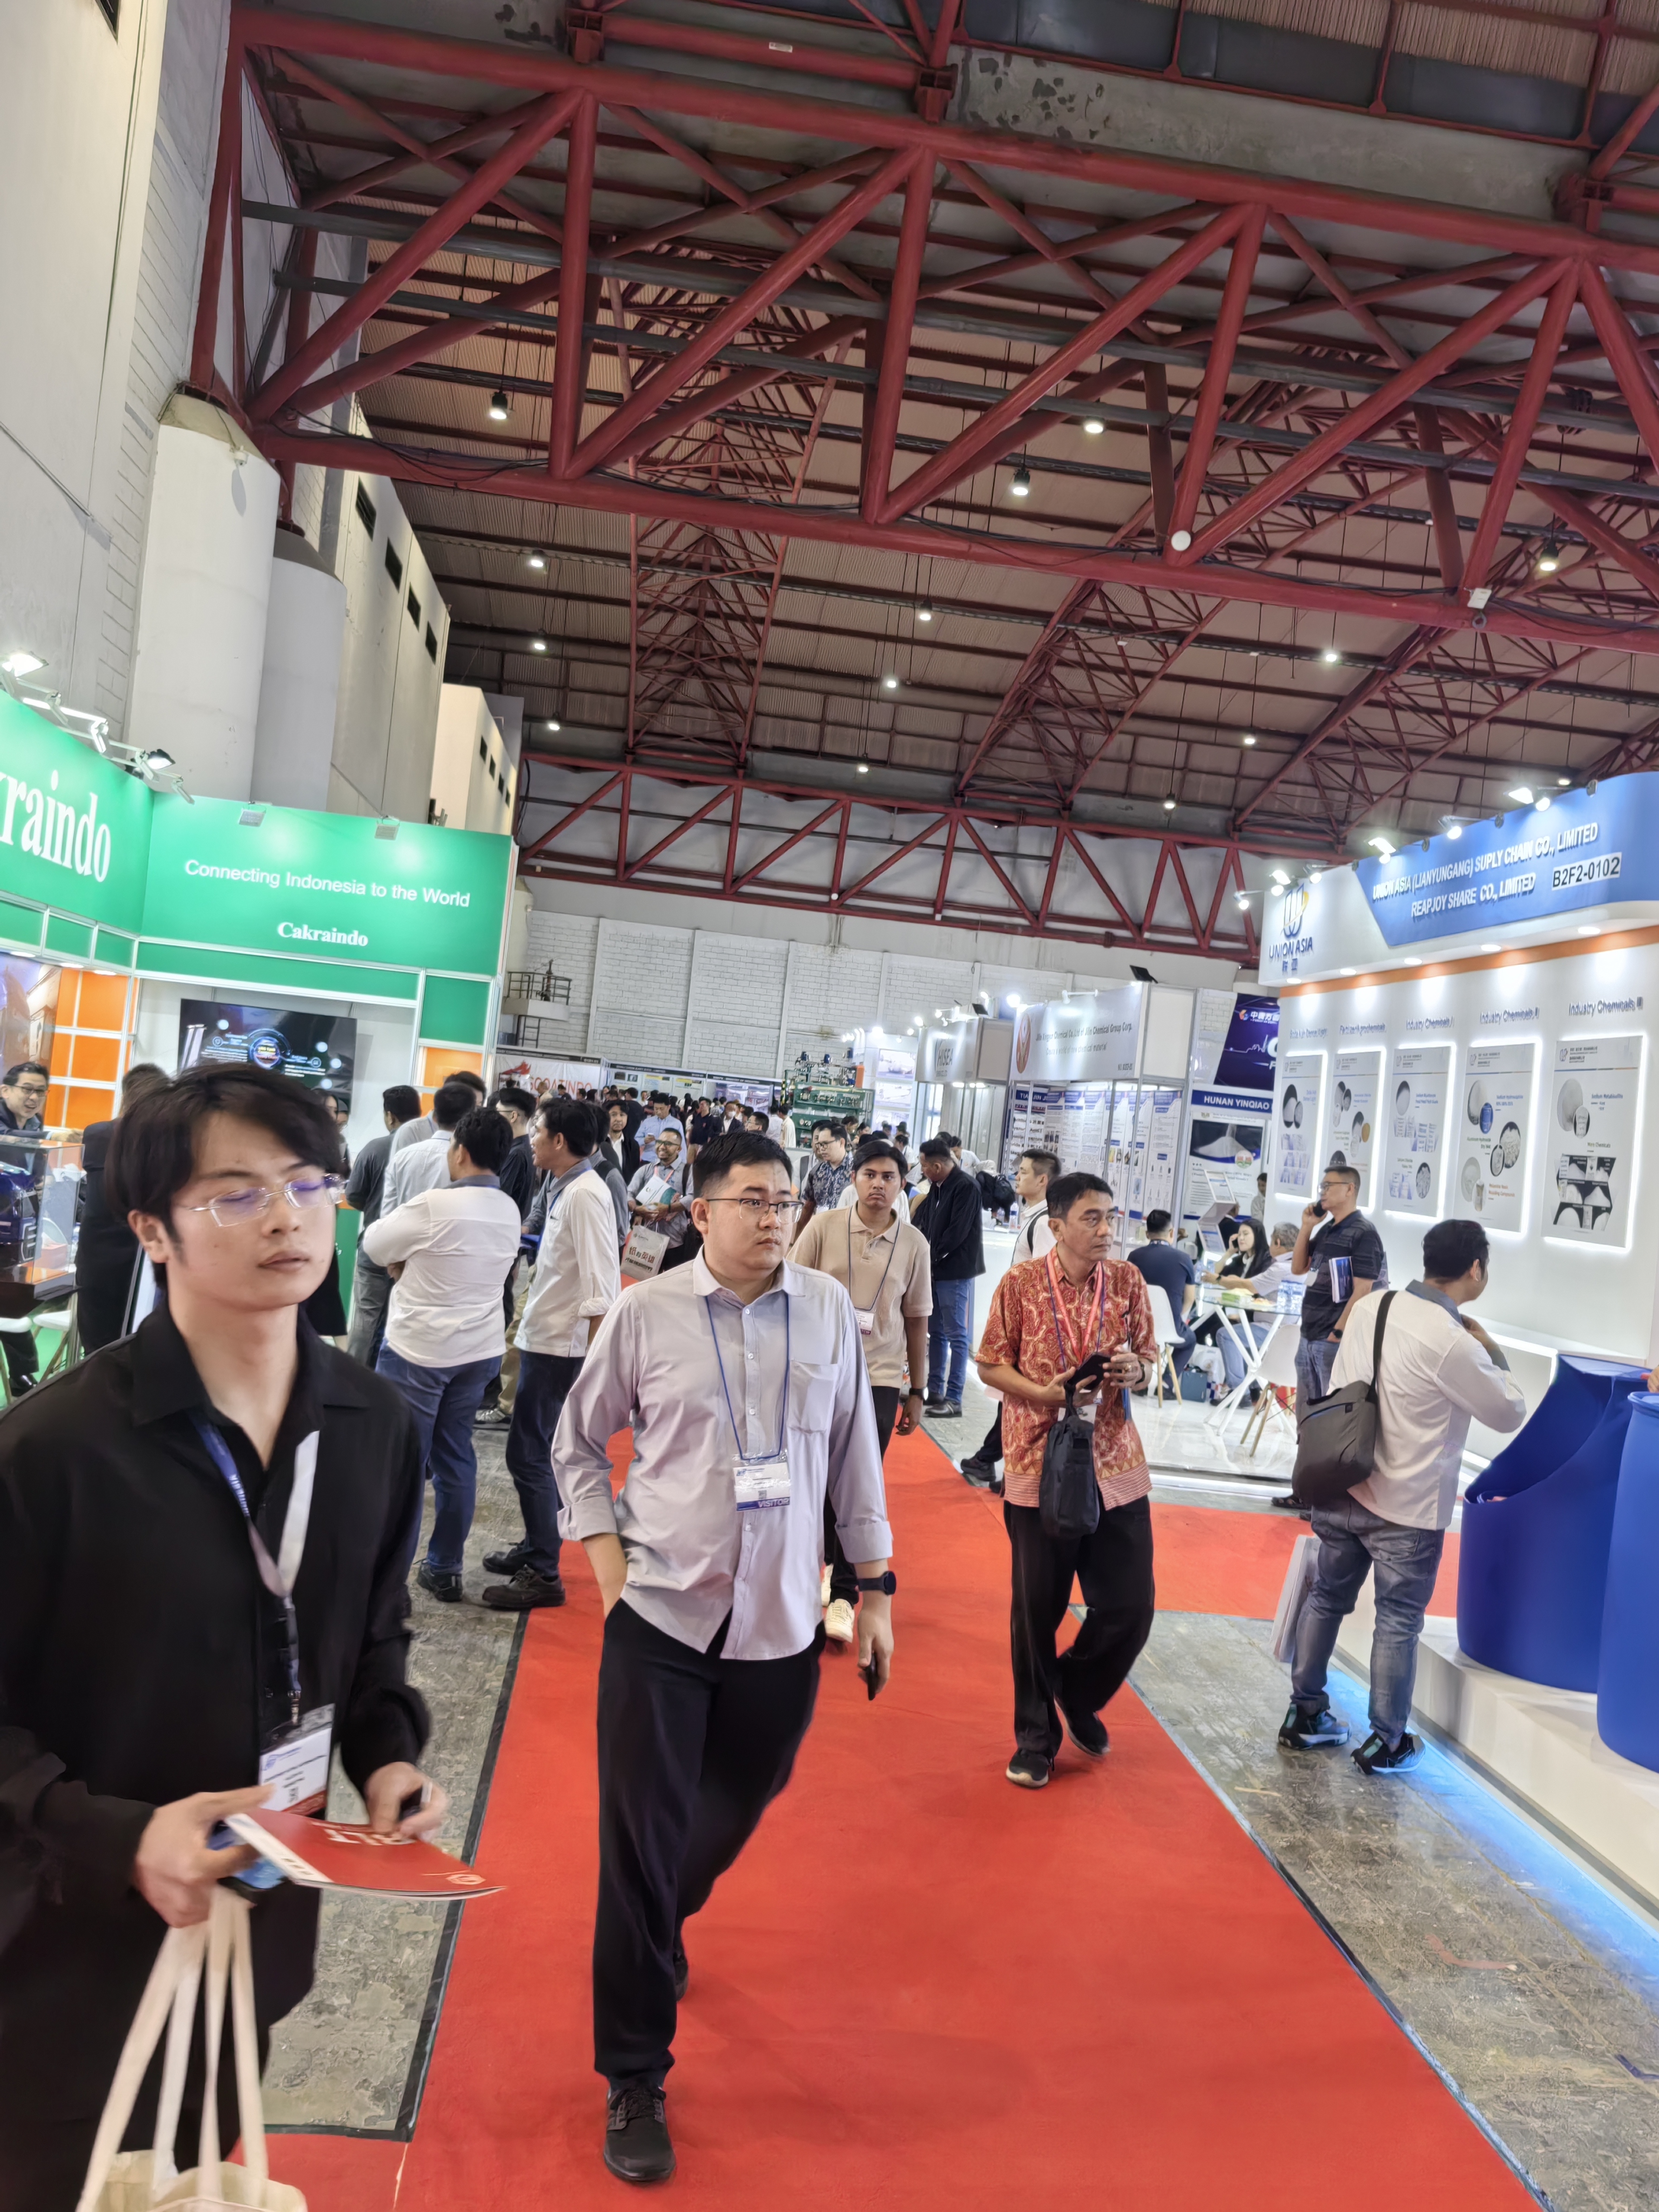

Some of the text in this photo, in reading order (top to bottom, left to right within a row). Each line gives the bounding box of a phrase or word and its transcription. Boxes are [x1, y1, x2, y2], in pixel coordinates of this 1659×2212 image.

[0, 769, 111, 882] raindo
[1372, 882, 1393, 900] UNION
[1393, 874, 1411, 895] ASIA
[1412, 857, 1473, 891] (LIANYUNGANG)
[1475, 849, 1502, 872] SUPLY
[1504, 841, 1533, 864] CHAIN
[1556, 822, 1599, 851] LIMITED
[1552, 857, 1620, 887] B2F2-0102
[185, 859, 471, 907] Connecting Indonesia to the World
[1448, 888, 1476, 909] SHARE
[1499, 872, 1536, 897] LIMITED
[277, 921, 368, 947] Cakraindo
[1269, 936, 1313, 959] UNION ASIA
[1480, 1011, 1501, 1024] Industry
[1503, 1007, 1533, 1020] Chemicals
[1569, 1002, 1596, 1017] Industry
[1597, 997, 1635, 1014] Chemicals
[1204, 1095, 1270, 1110] HUNAN YINQIAO
